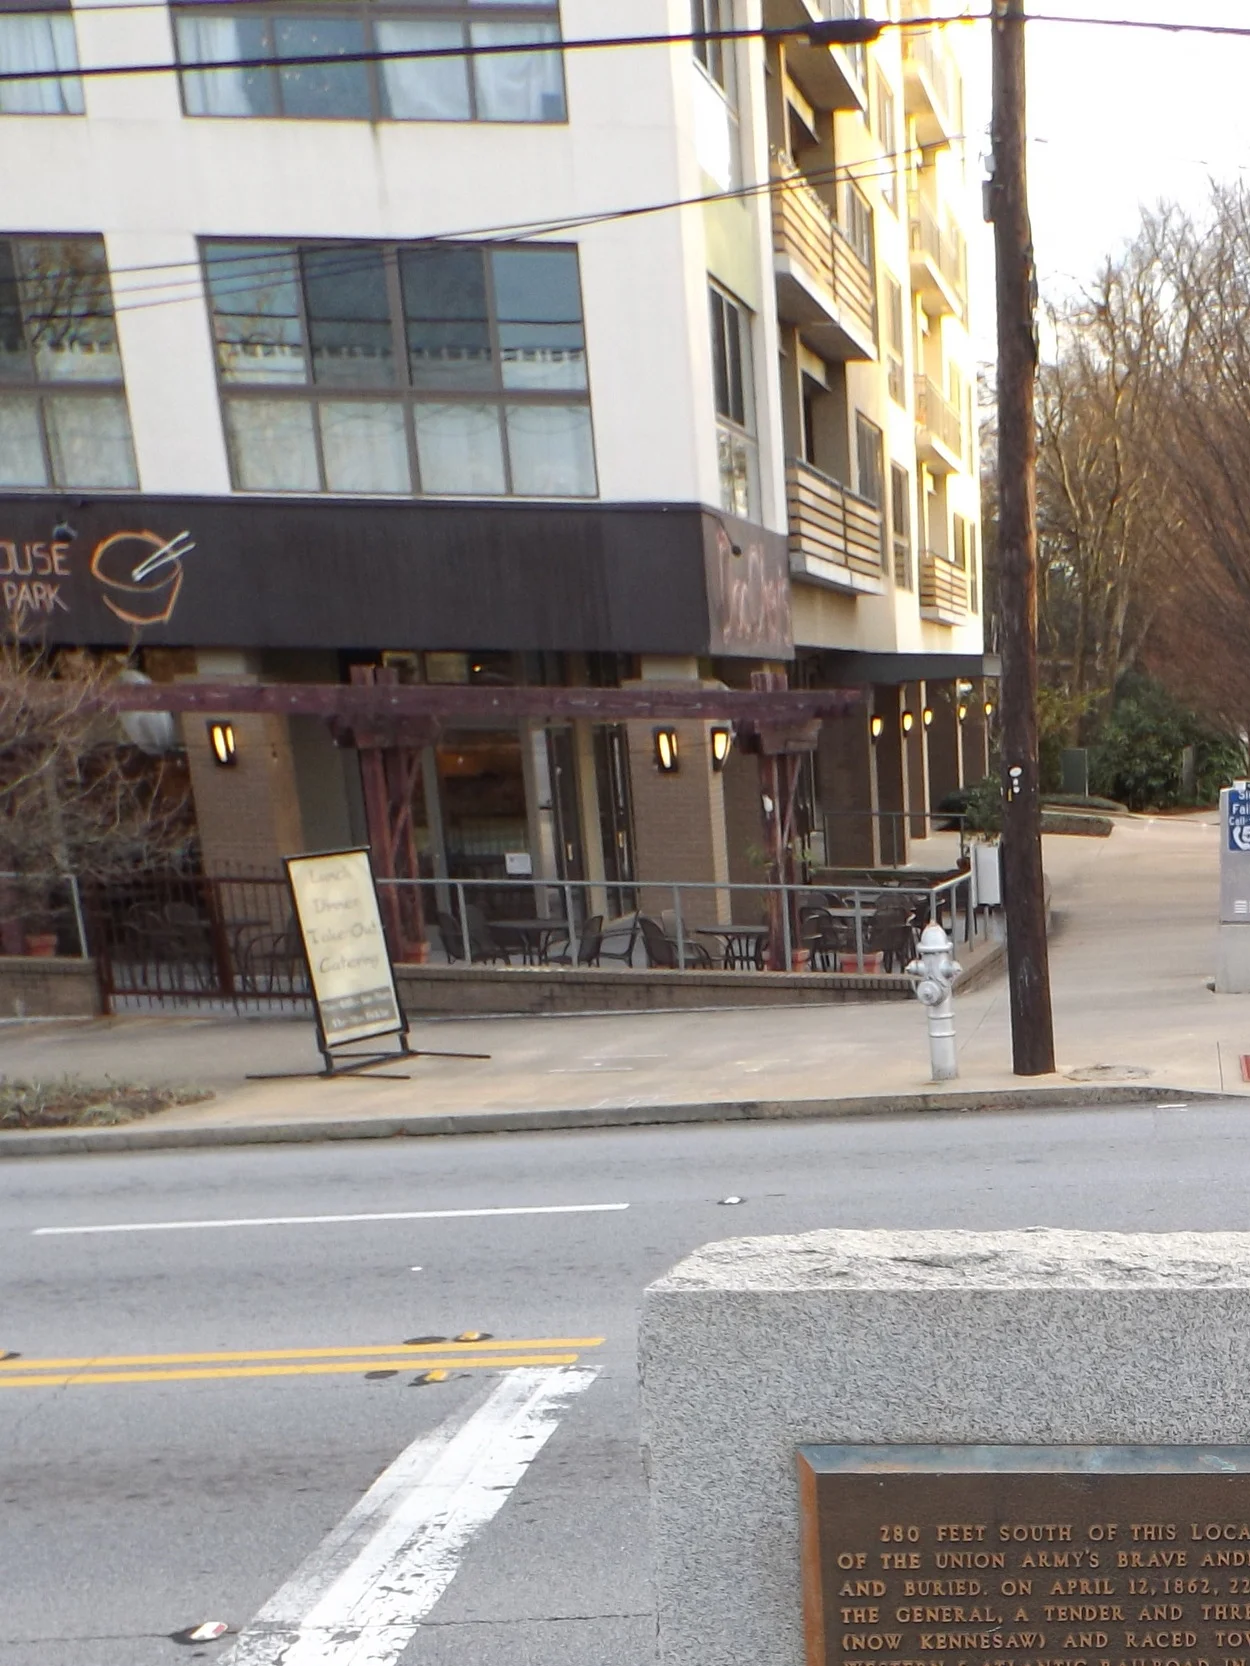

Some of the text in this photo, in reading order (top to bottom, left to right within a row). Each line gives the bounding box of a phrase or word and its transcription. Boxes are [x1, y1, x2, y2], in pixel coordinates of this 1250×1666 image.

[2, 581, 69, 612] PARK
[1229, 816, 1246, 826] Call
[319, 955, 379, 974] Catering
[879, 1525, 921, 1541] 280
[936, 1524, 987, 1541] FEET
[999, 1524, 1072, 1541] SOUTH
[1087, 1523, 1119, 1540] OF
[1129, 1524, 1177, 1540] THIS
[836, 1553, 868, 1569] OF
[879, 1552, 922, 1569] THE
[934, 1551, 1006, 1568] UNION
[1021, 1549, 1100, 1567] ARMY'S
[1116, 1550, 1188, 1566] BRAVE
[839, 1580, 887, 1596] AND
[903, 1578, 988, 1596] BURIED.
[1000, 1579, 1033, 1595] ON
[1049, 1577, 1115, 1594] APRIL
[1128, 1577, 1157, 1595] 12,
[1163, 1577, 1219, 1595] 1862,
[1229, 1576, 1250, 1594] 22
[840, 1607, 880, 1622] THE
[895, 1605, 1004, 1623] GENERAL,
[1013, 1606, 1029, 1621] A
[1043, 1605, 1125, 1621] TENDER
[1138, 1603, 1183, 1620] AND
[841, 1634, 903, 1650] (NOW
[919, 1630, 1046, 1648] KENNESAW)
[1062, 1631, 1109, 1648] AND
[1124, 1631, 1198, 1647] RACED
